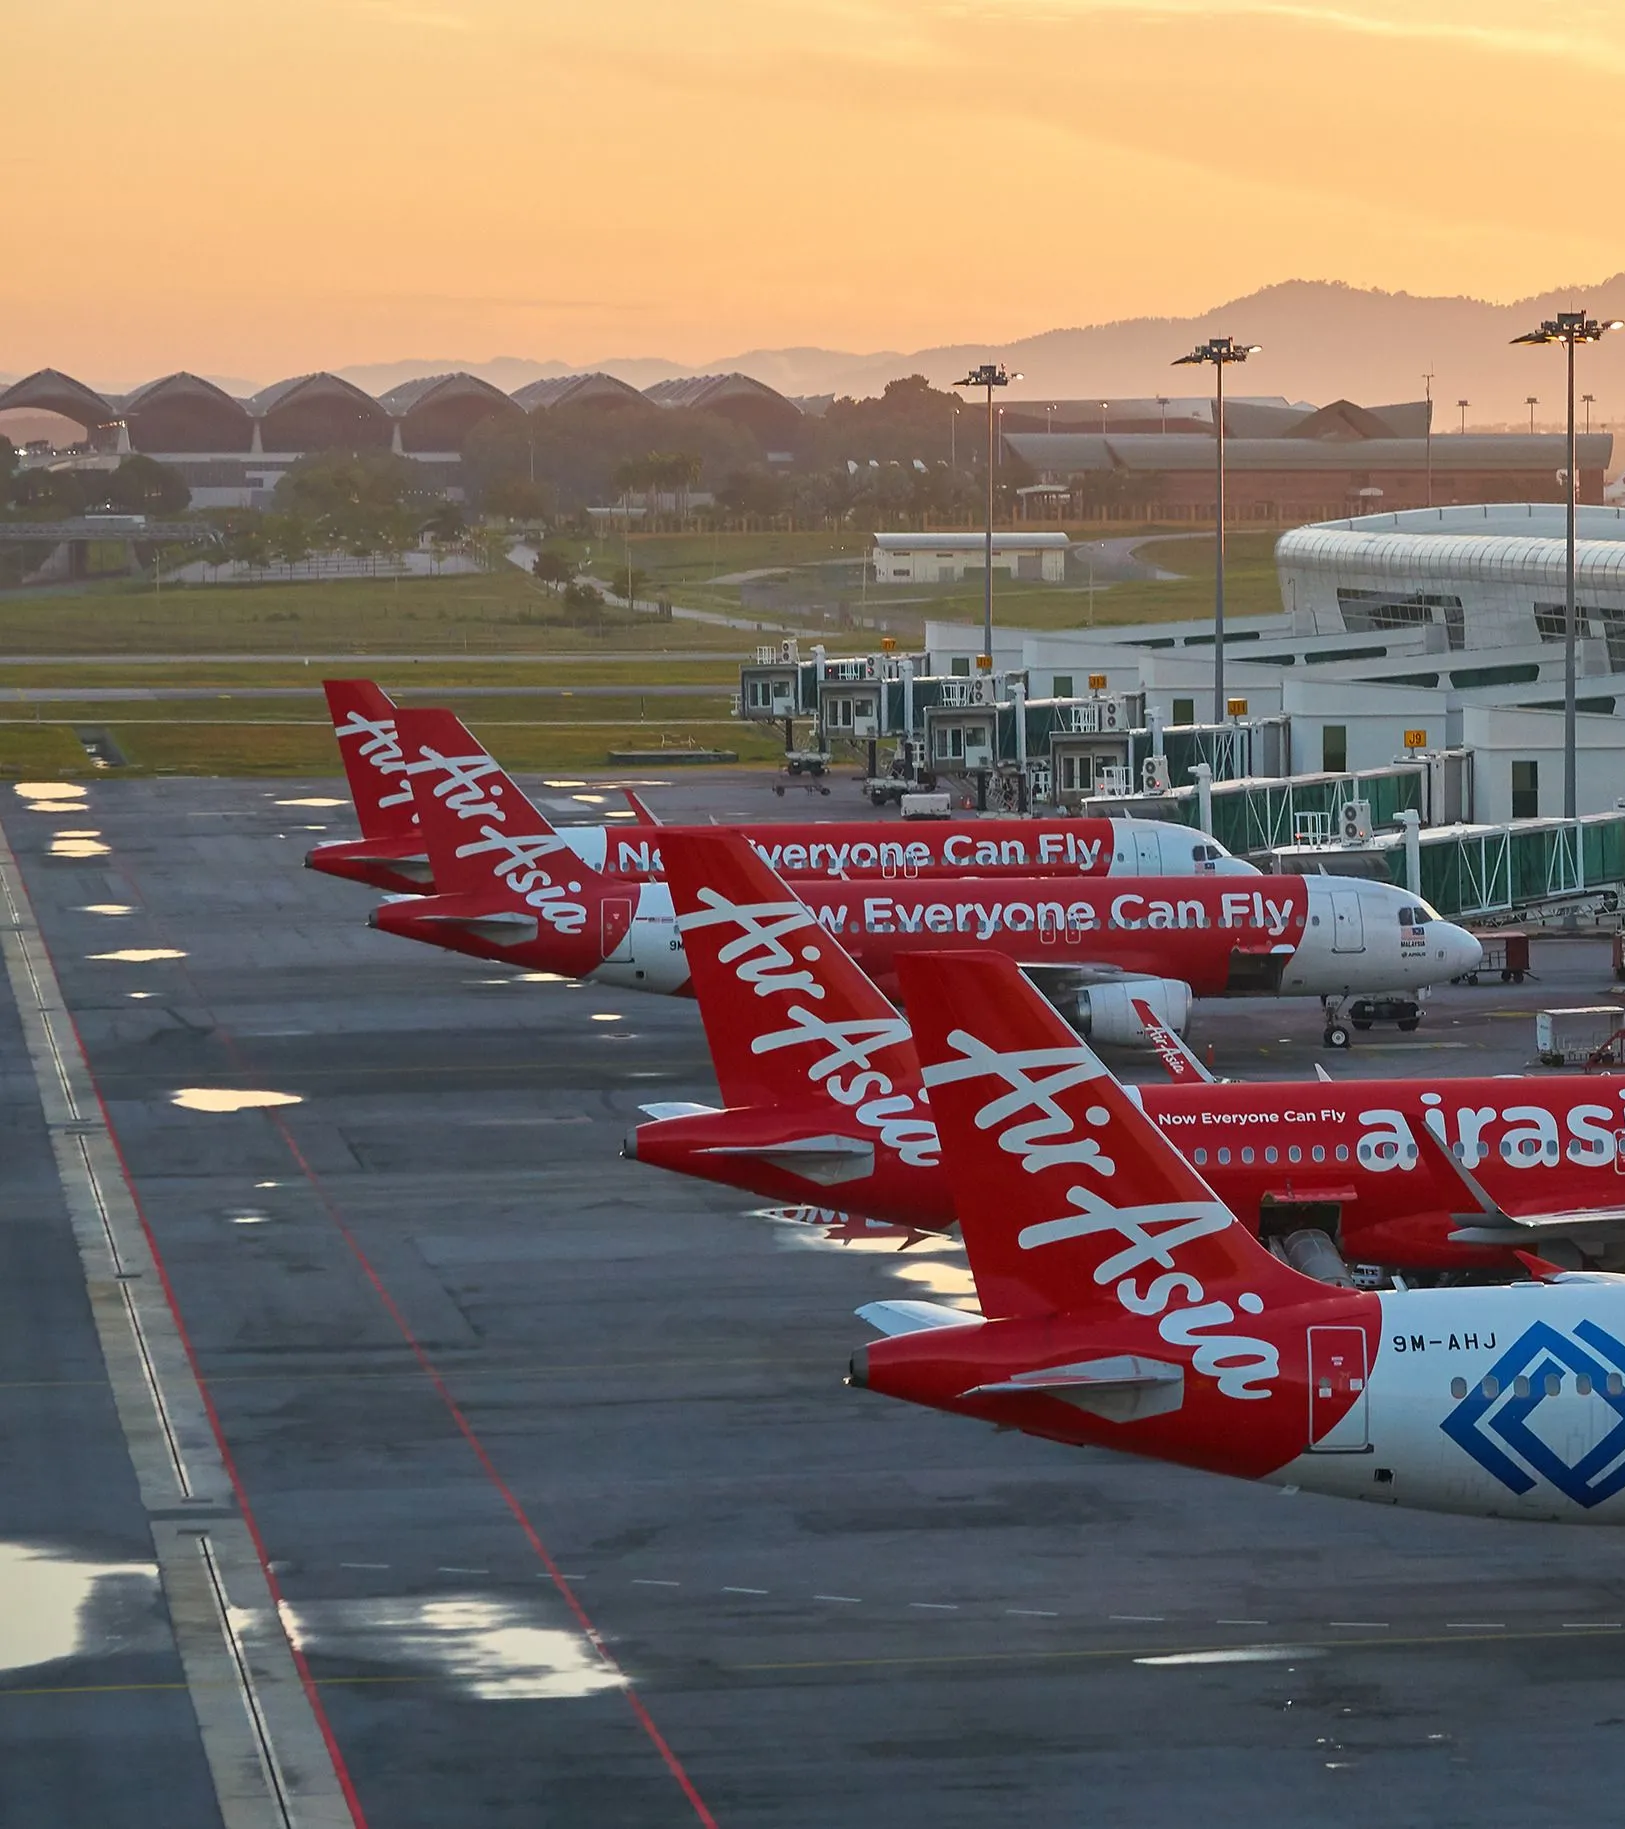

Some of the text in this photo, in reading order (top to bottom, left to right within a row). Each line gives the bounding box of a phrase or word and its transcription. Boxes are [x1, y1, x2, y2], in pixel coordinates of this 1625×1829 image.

[1409, 732, 1422, 745] J9
[752, 832, 1102, 876] veryone Can Fly
[456, 825, 587, 934] Asia
[864, 897, 1096, 941] Everyone
[1110, 893, 1201, 931] Can
[1221, 891, 1294, 937] Fly
[677, 886, 826, 1000] Air
[1158, 1109, 1347, 1126] Now Everyone Can Fly
[922, 1028, 1280, 1400] Air Asia
[1392, 1331, 1497, 1354] 9M-AHJ
